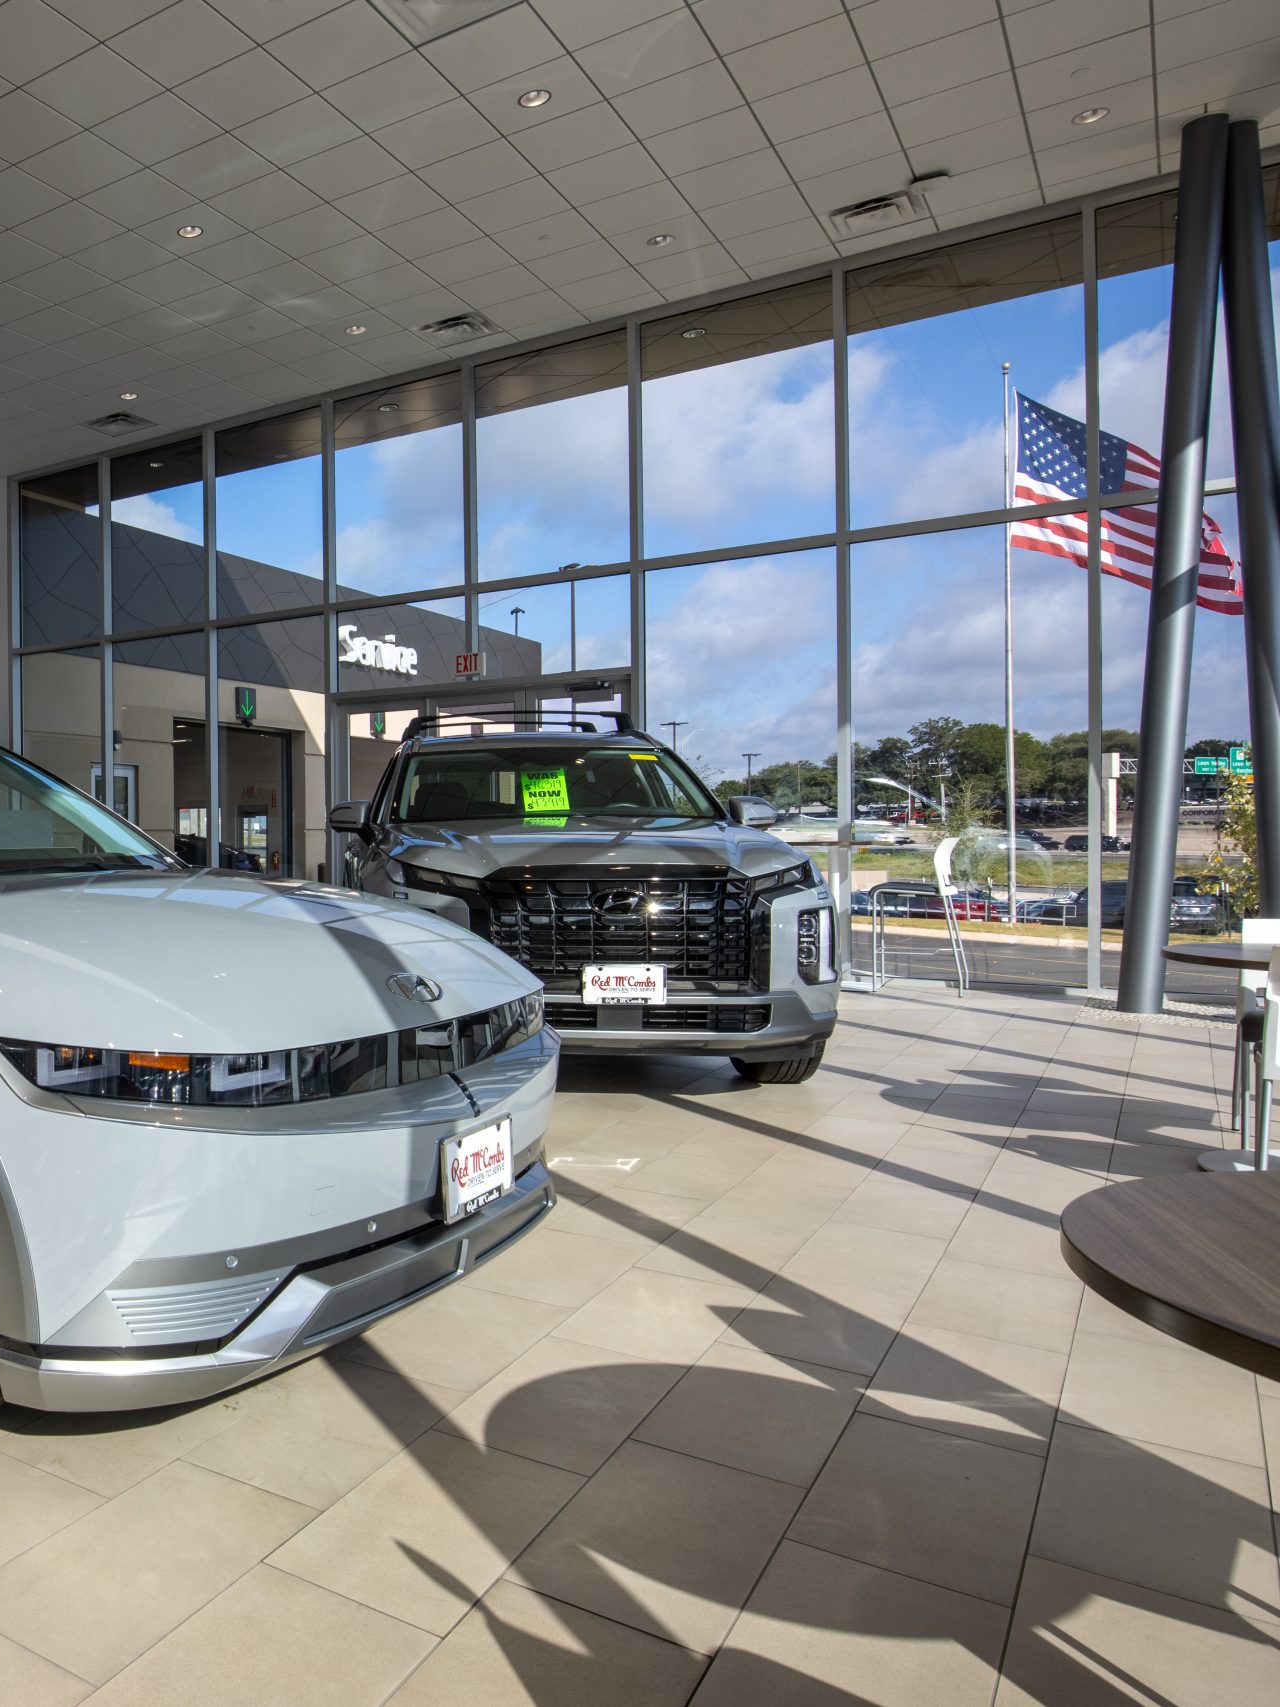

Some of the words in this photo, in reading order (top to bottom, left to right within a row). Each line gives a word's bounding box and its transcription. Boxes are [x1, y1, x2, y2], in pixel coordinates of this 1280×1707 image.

[338, 624, 418, 676] Service
[456, 653, 479, 673] EXIT
[527, 772, 559, 780] WAS
[528, 790, 561, 798] NOW
[591, 975, 611, 991] Red
[613, 975, 656, 988] McCombs
[451, 1155, 469, 1188] Red
[470, 1142, 505, 1173] McCombs
[467, 1172, 485, 1187] DRIVEN
[485, 1169, 493, 1179] TO
[492, 1162, 505, 1175] SERVE
